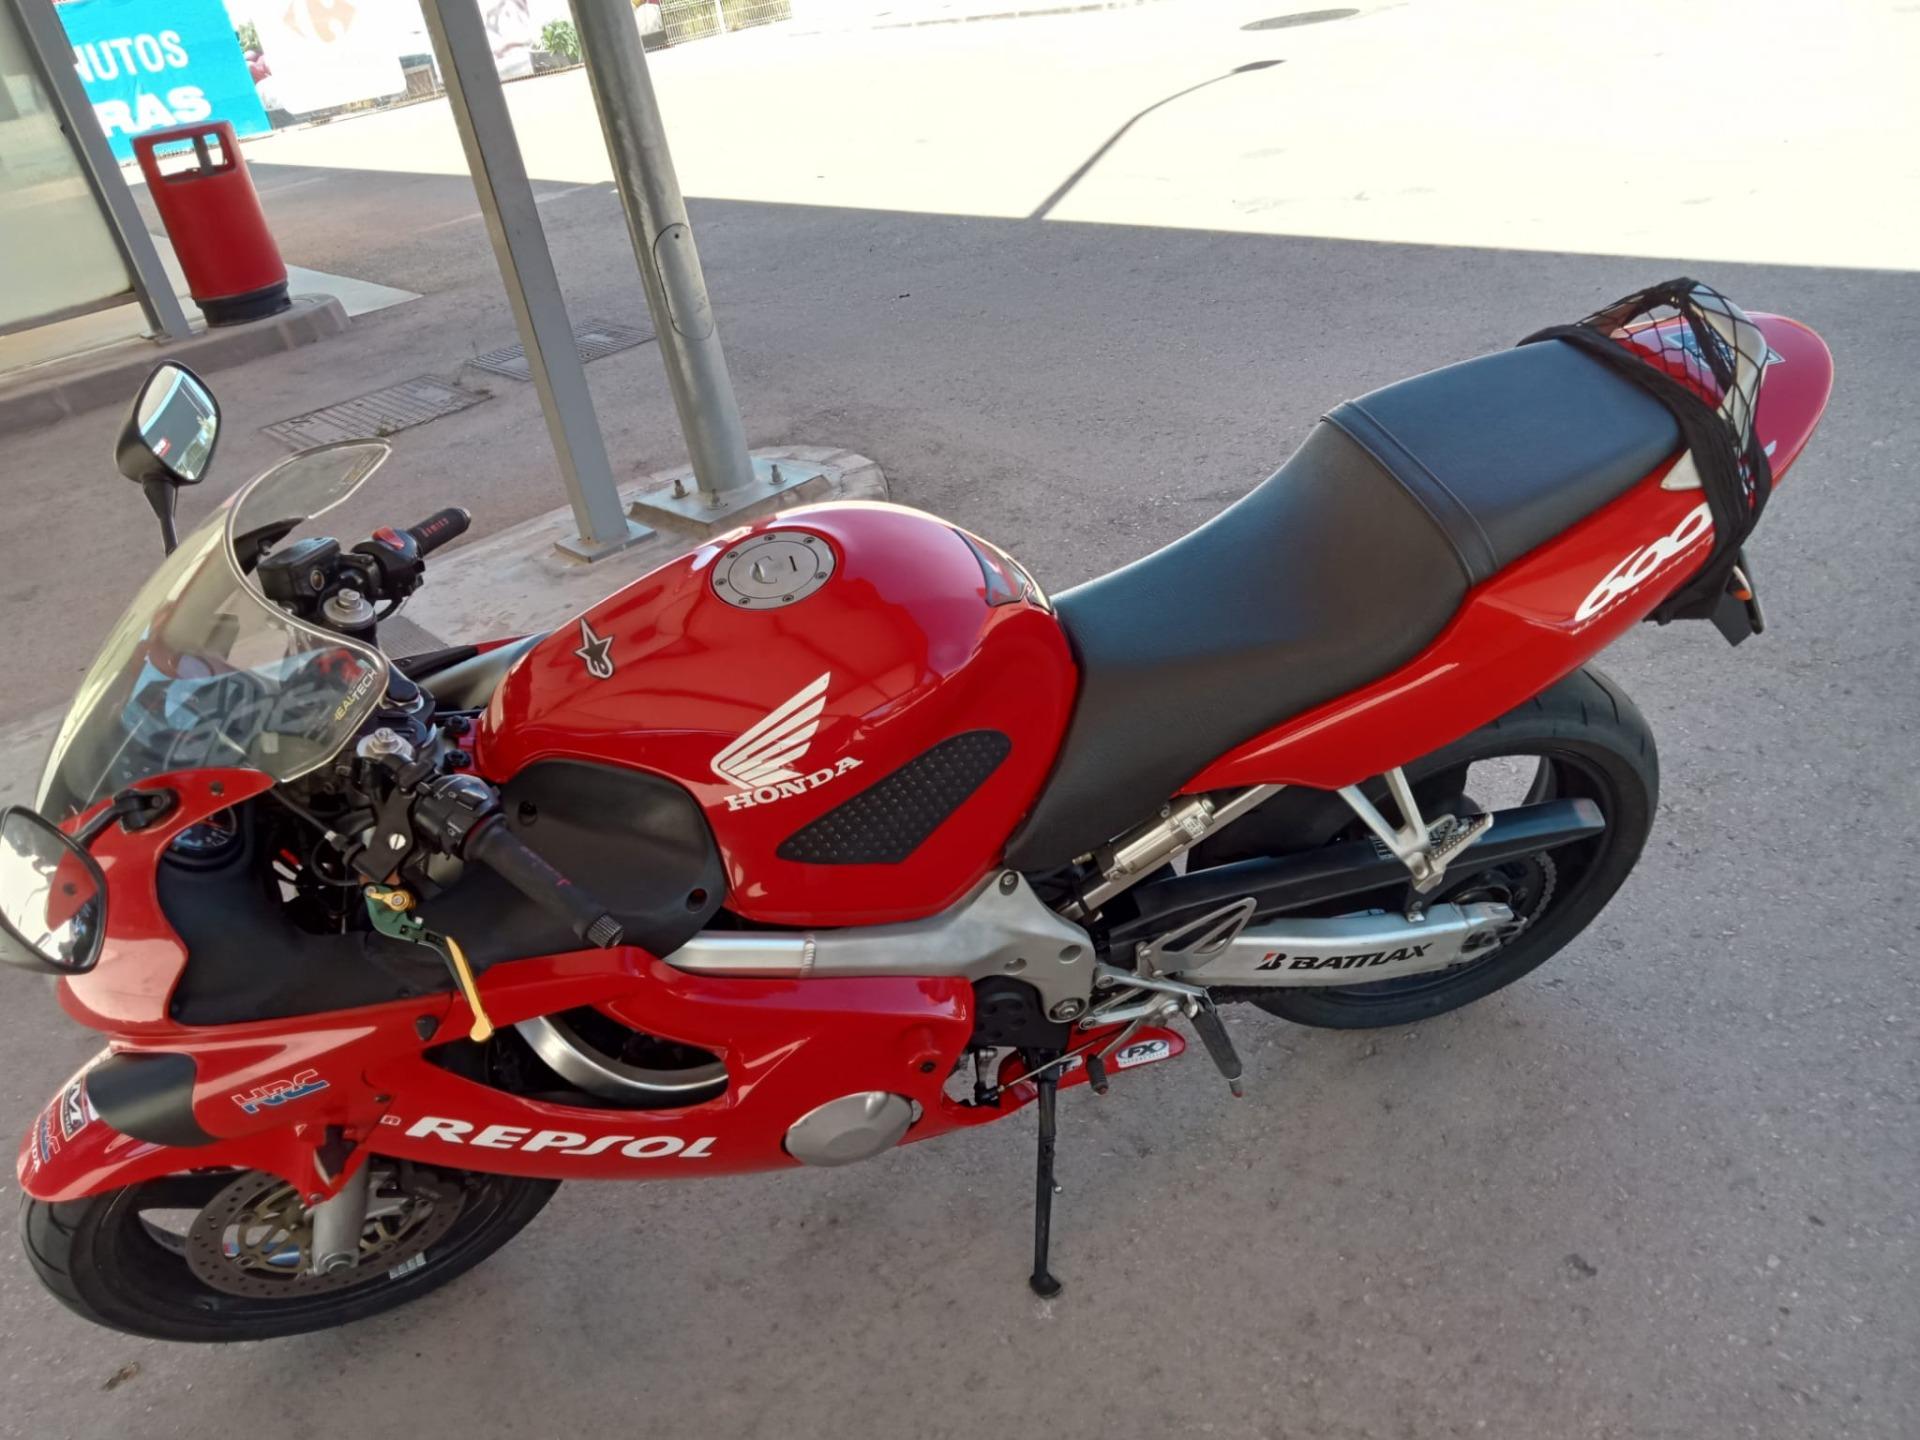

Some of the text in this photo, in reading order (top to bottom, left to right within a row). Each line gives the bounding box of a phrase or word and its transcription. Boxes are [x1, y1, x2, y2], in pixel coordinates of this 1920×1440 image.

[93, 85, 212, 138] RAS
[1574, 501, 1714, 623] 600
[723, 756, 864, 812] HONDA
[1288, 943, 1434, 970] BATTLAX
[1127, 1041, 1156, 1059] FX
[231, 1068, 331, 1114] HRC
[404, 1115, 718, 1158] REPSOL
